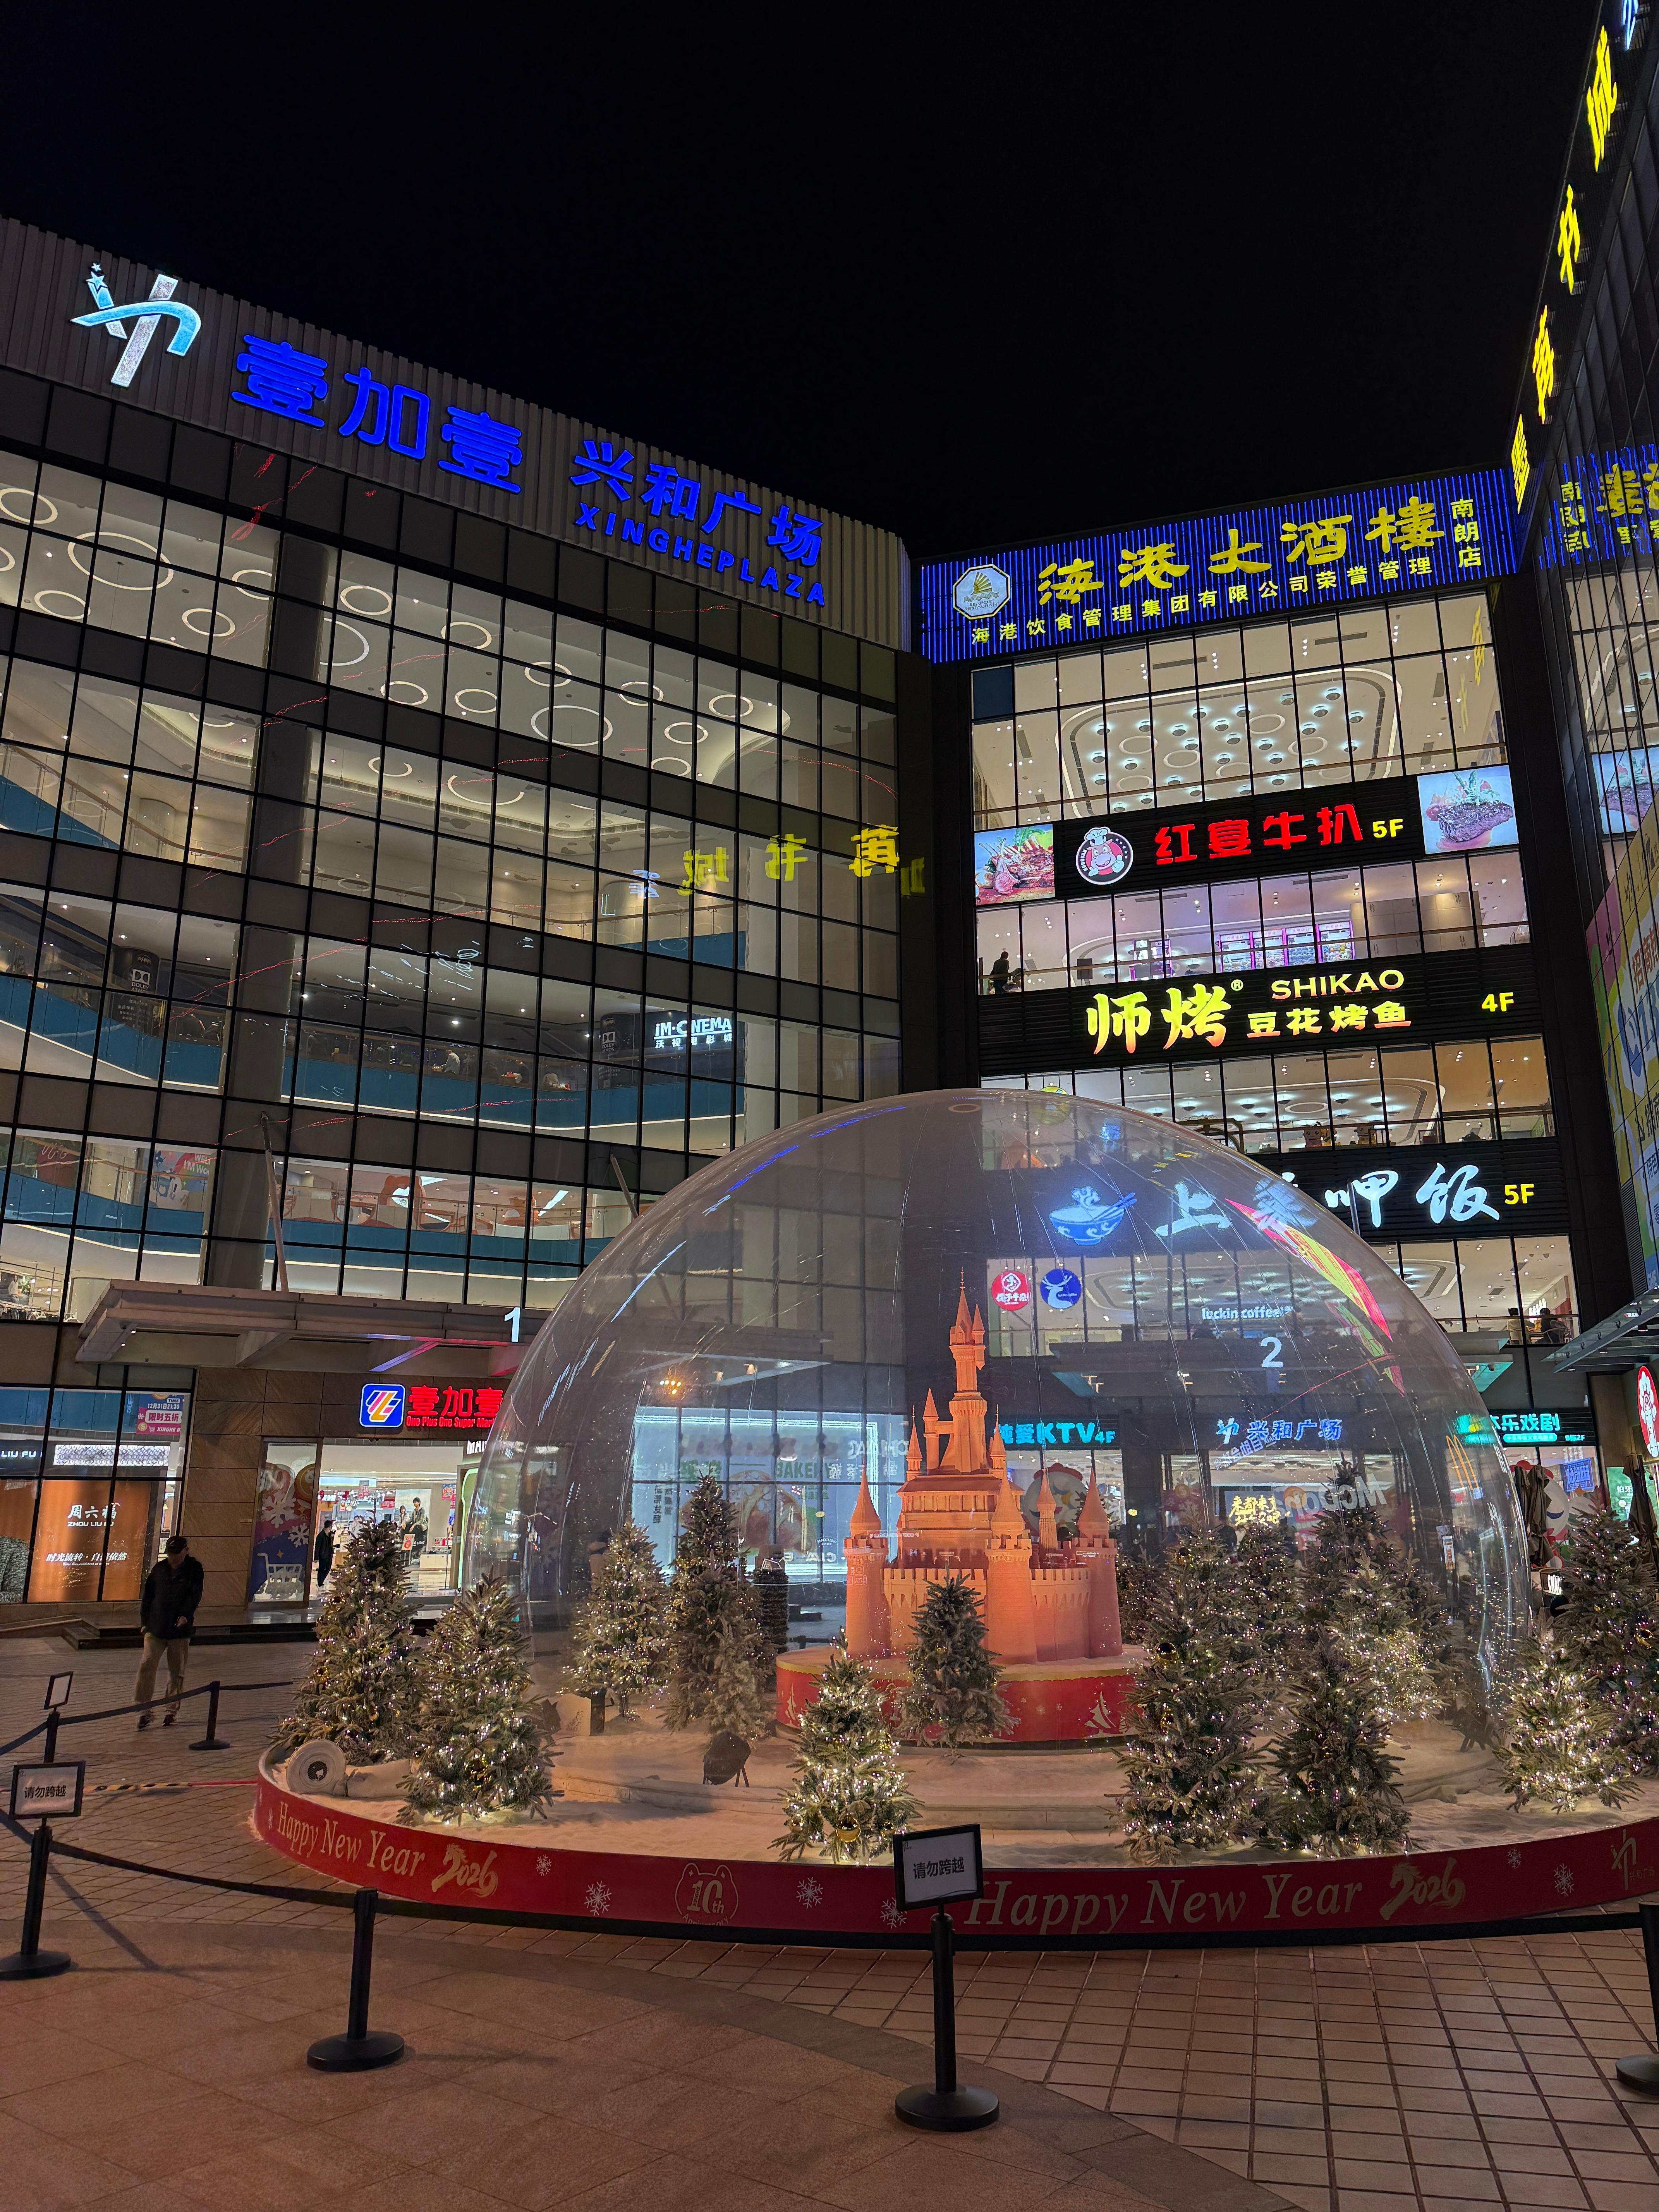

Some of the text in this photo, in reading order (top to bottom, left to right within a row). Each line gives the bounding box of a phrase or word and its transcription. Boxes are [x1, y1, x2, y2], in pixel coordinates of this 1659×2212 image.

[231, 335, 522, 494] 壹加壹
[569, 440, 823, 566] 兴和广场
[1450, 498, 1482, 568] 南朗店
[964, 602, 1000, 610] RESTAURANT
[971, 556, 1432, 645] 海港饮食管理集团有限公司荣誉管理
[1372, 818, 1403, 838] 5F
[1272, 969, 1405, 1000] SHIKAO
[1482, 992, 1514, 1012] 4F
[1087, 983, 1231, 1054] 师烤
[1247, 1000, 1412, 1038] 豆花烤鱼
[1504, 1183, 1534, 1204] 5F
[504, 1307, 520, 1343] 1
[1202, 1306, 1281, 1319] luckin coffee
[1260, 1337, 1283, 1367] 2
[407, 1385, 503, 1417] 壹加壹
[148, 1412, 179, 1422] 限时五折
[406, 1416, 420, 1427] One
[422, 1416, 438, 1427] Plus
[439, 1417, 452, 1427] One
[454, 1417, 475, 1428] Super
[1247, 1419, 1342, 1441] 兴和广场
[1095, 1431, 1115, 1444] 4F
[24, 1785, 66, 1799] 请勿跨越
[277, 1801, 499, 1898] Happy New Year 2026
[913, 1856, 965, 1879] 请勿跨越
[963, 1858, 1465, 1936] Happy New Year 2026
